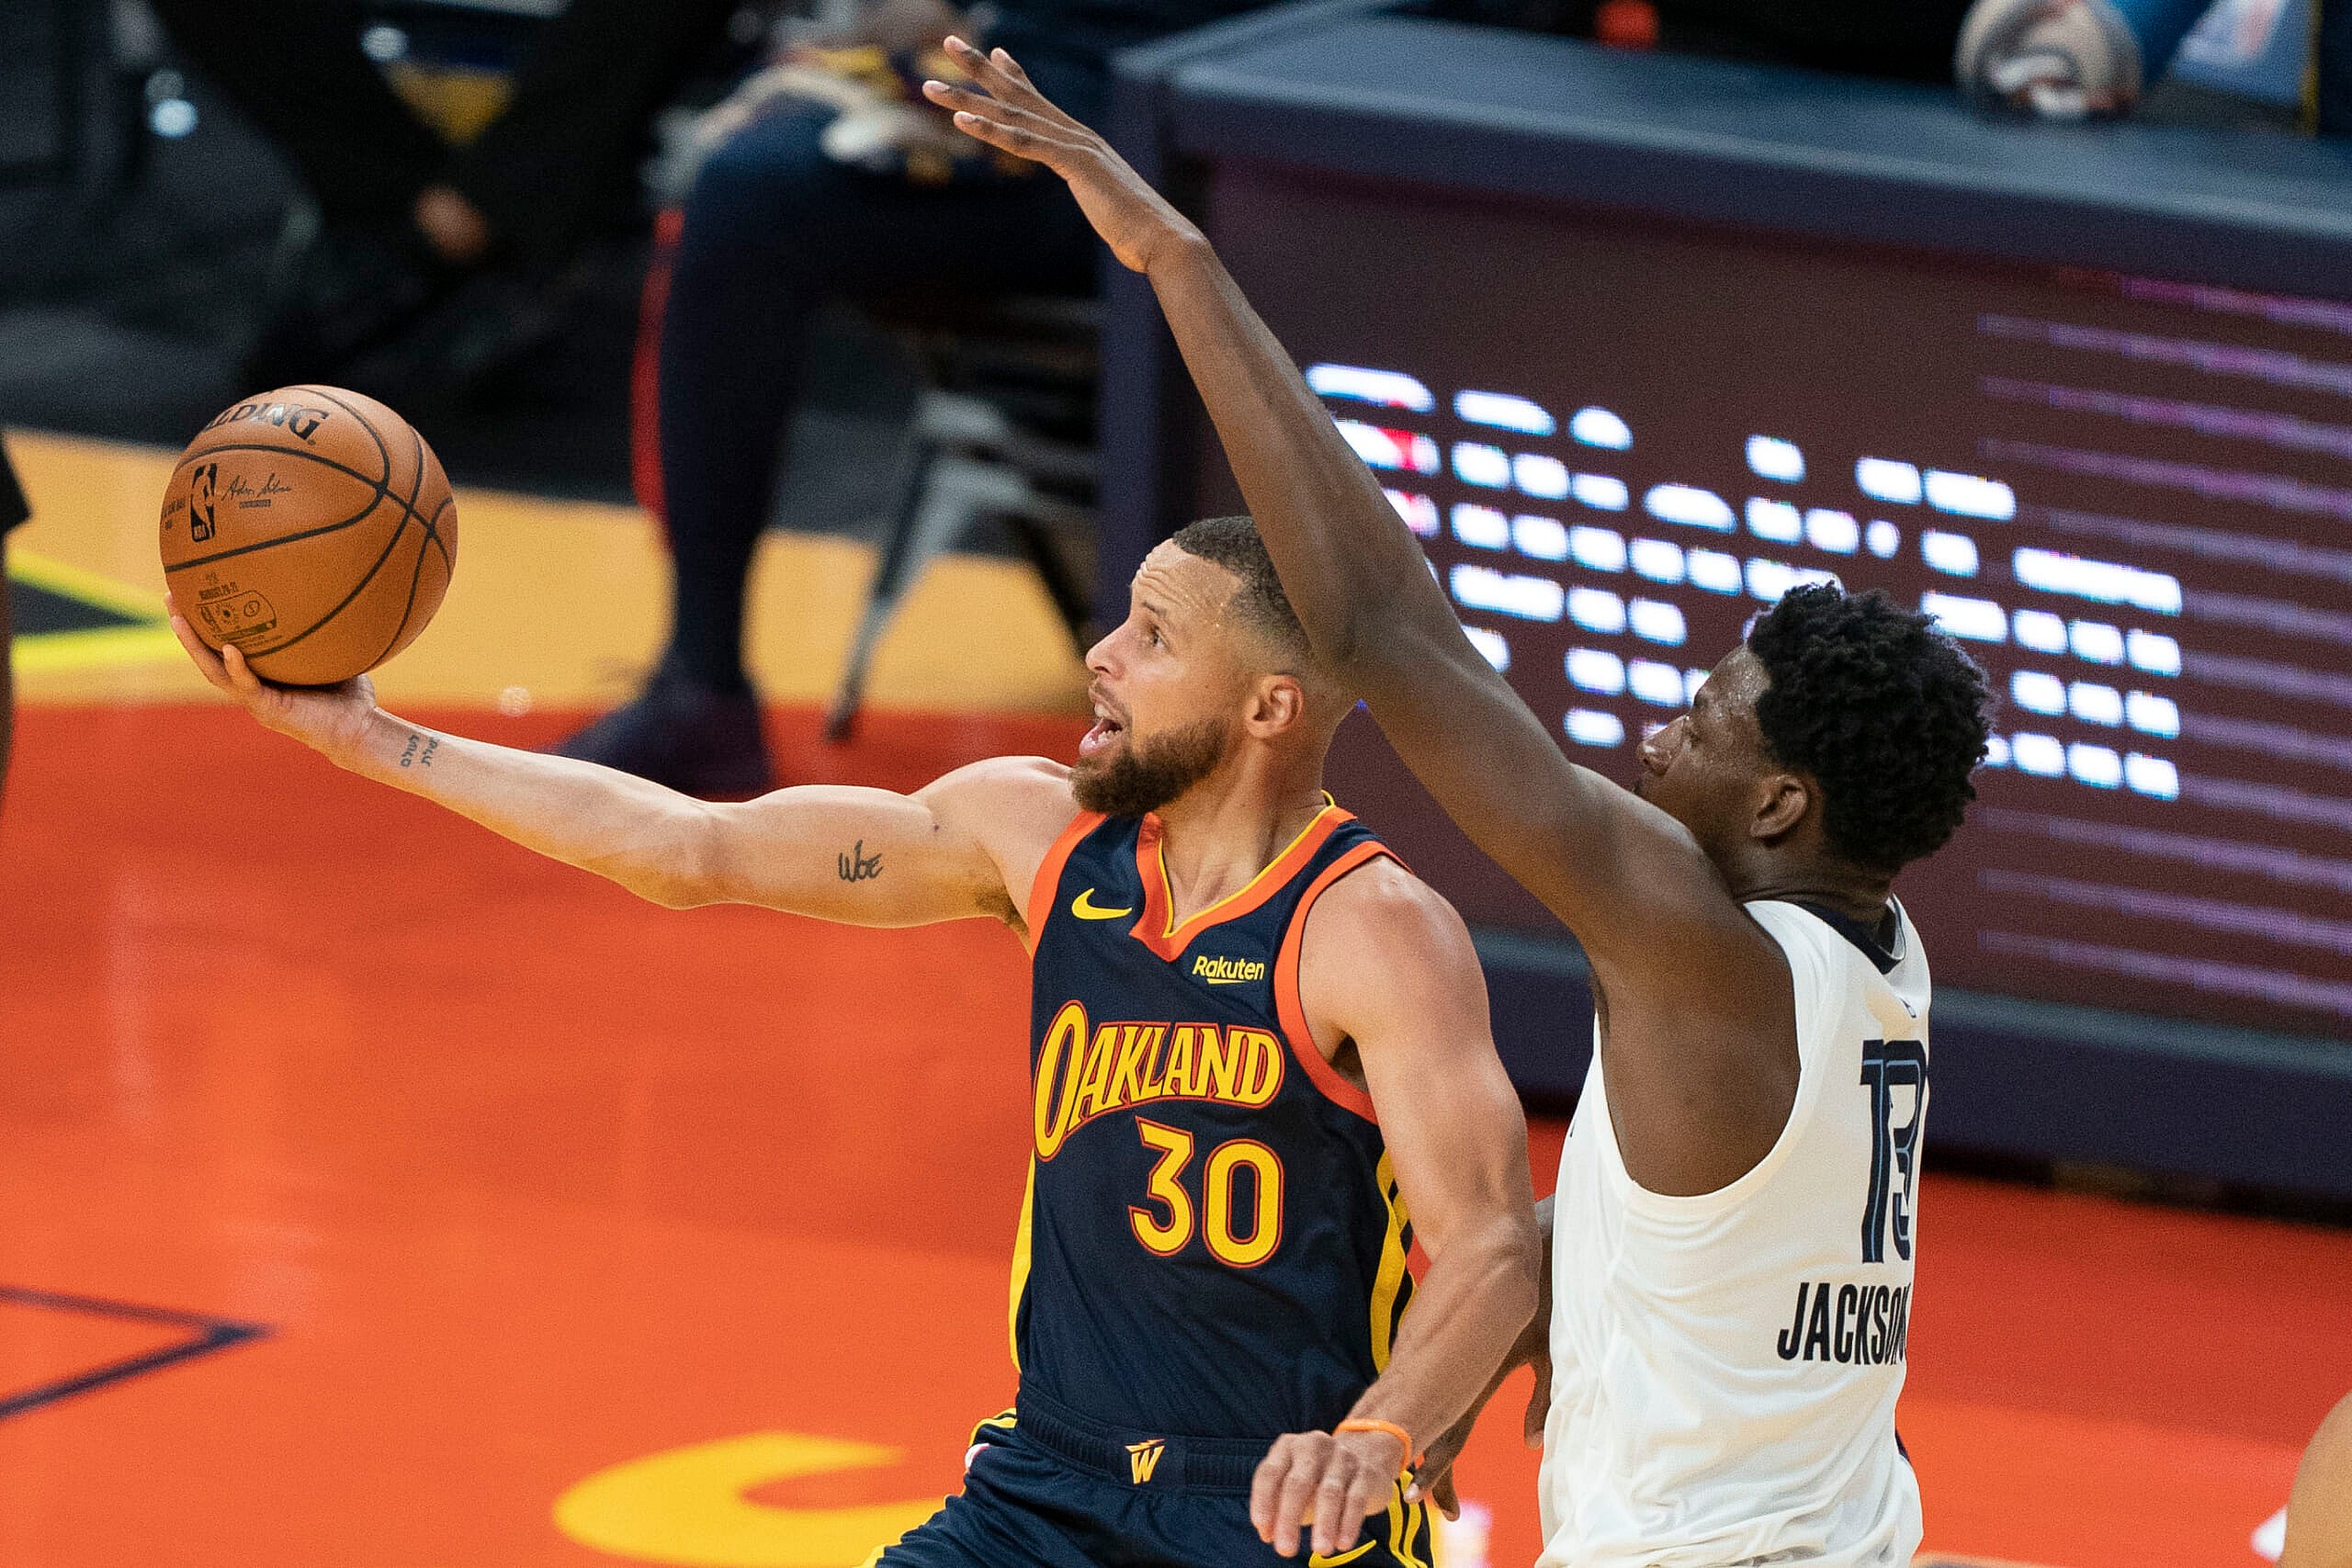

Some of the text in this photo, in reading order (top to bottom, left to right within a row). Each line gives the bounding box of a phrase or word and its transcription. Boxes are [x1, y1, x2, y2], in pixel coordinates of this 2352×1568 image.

[1192, 954, 1265, 981] Rakuten
[1034, 999, 1285, 1162] OAKLAND
[1128, 1115, 1284, 1269] 30
